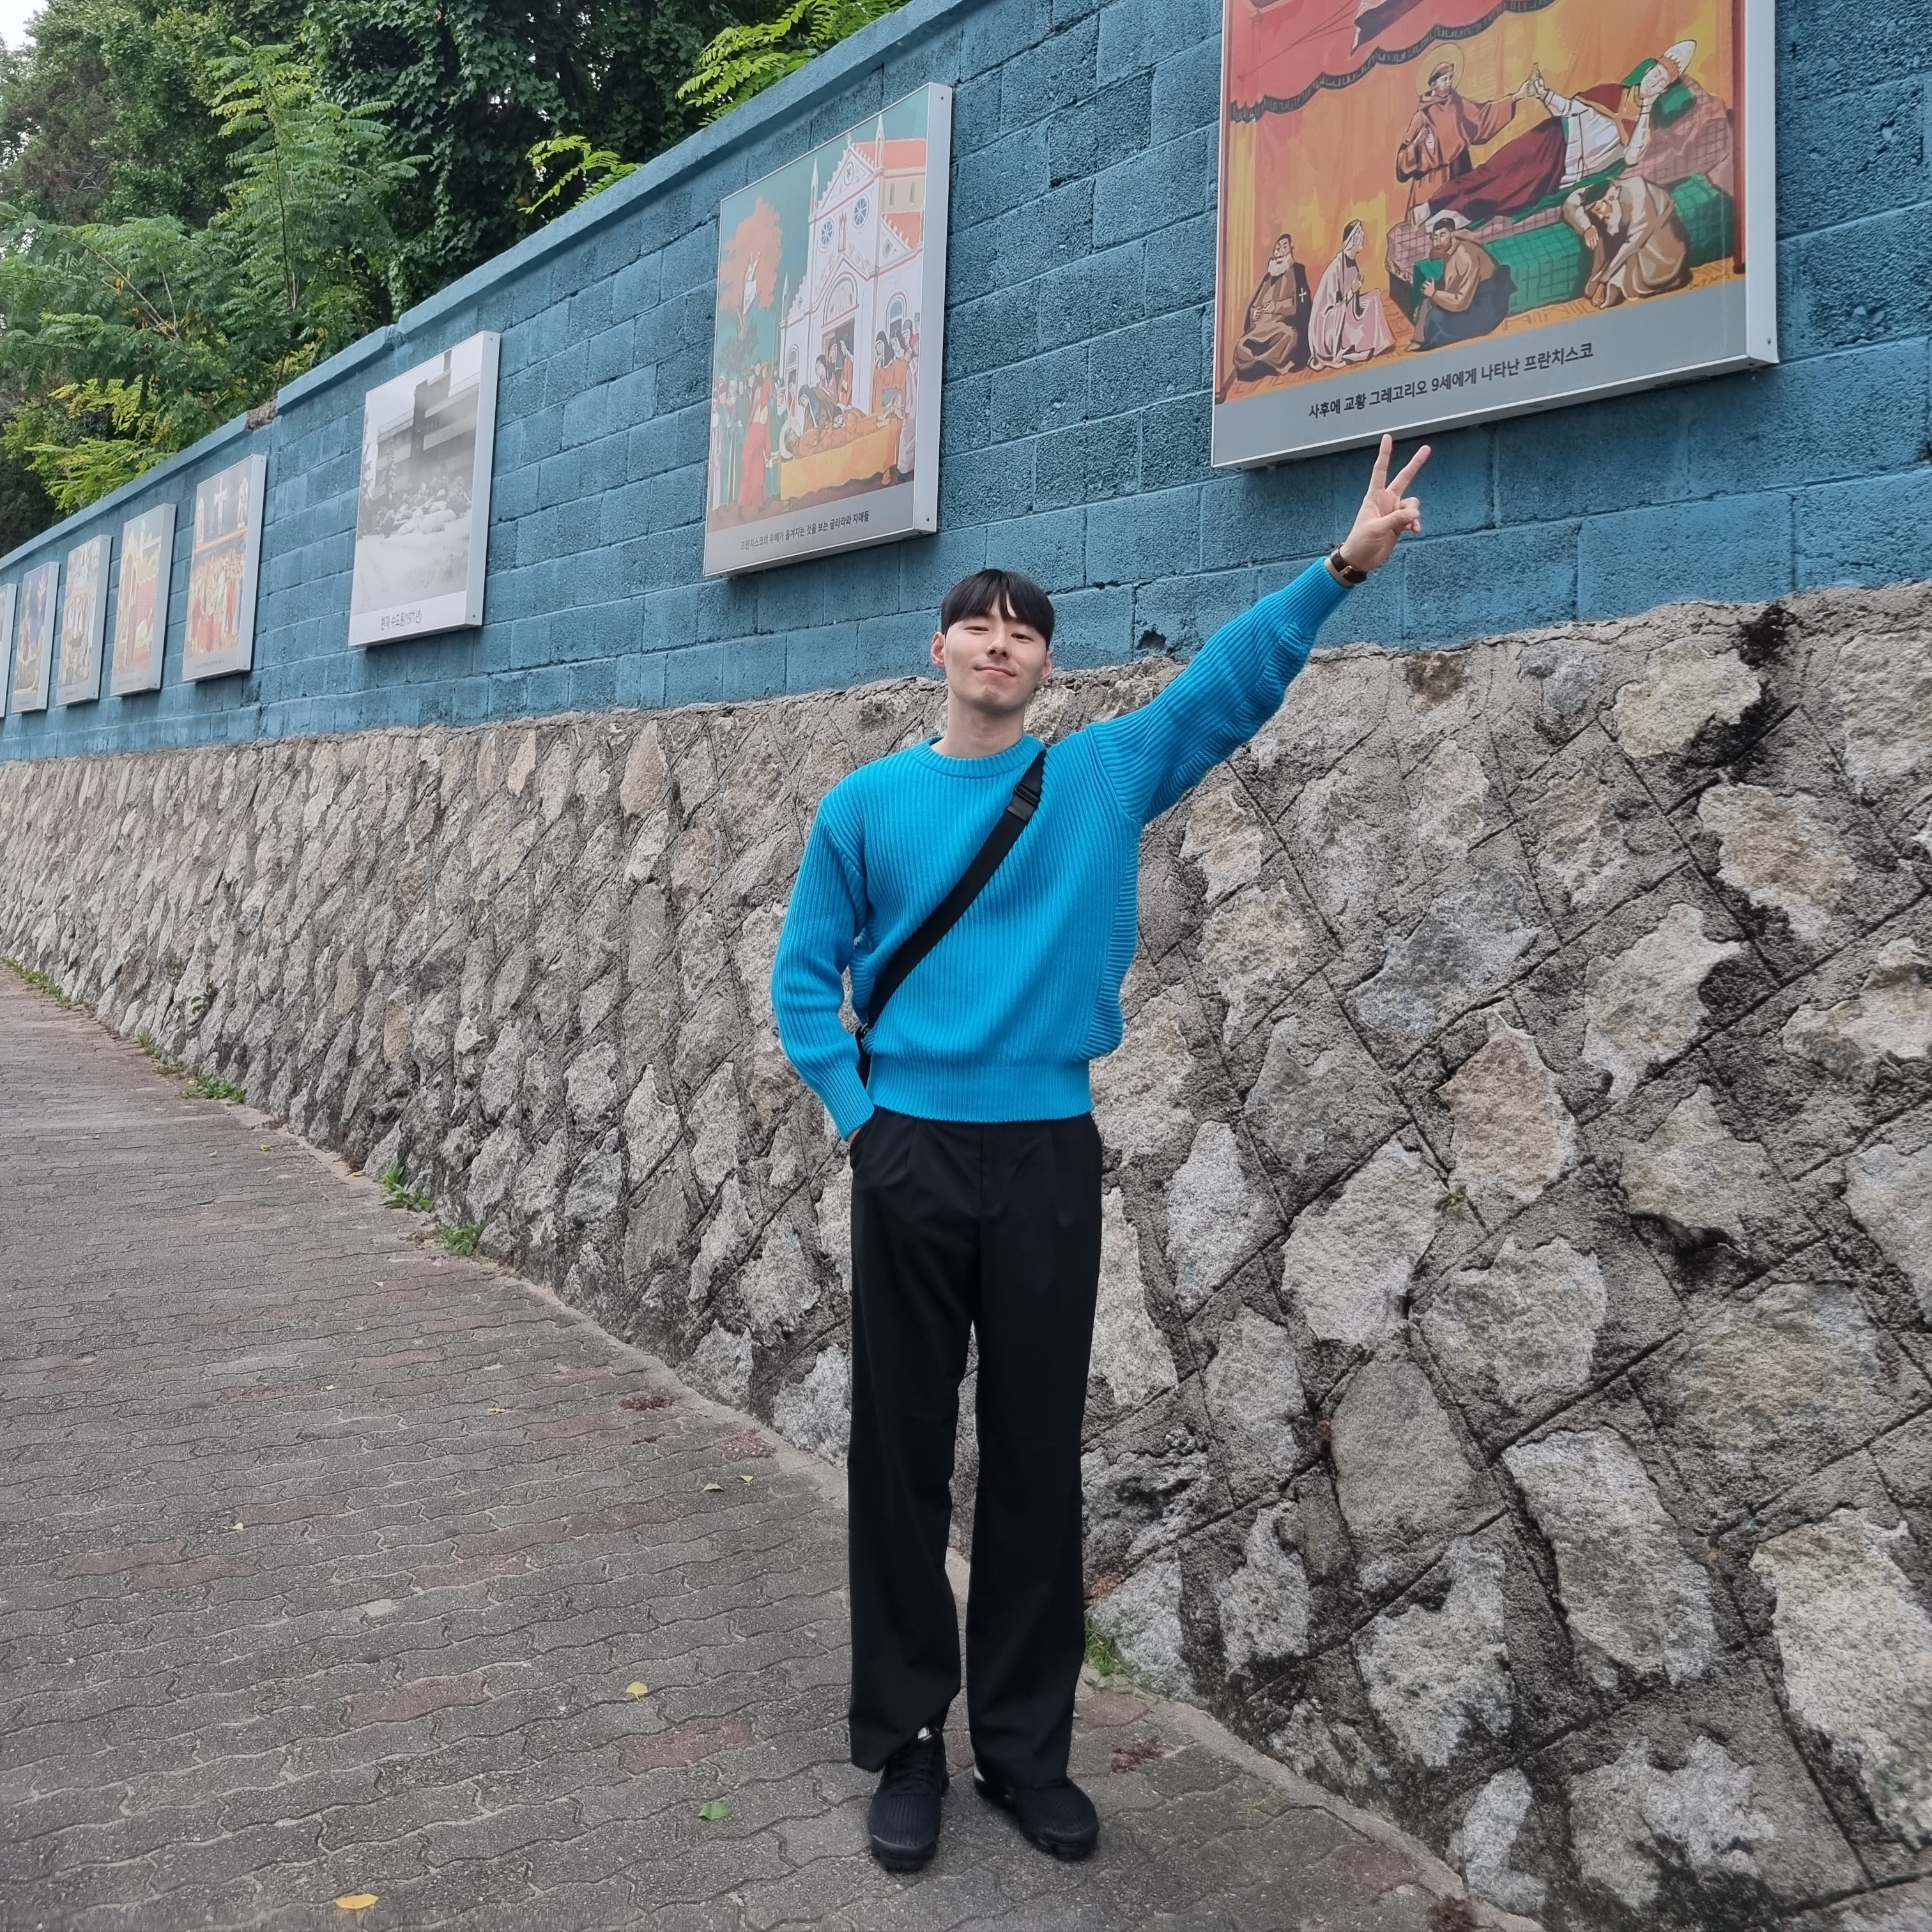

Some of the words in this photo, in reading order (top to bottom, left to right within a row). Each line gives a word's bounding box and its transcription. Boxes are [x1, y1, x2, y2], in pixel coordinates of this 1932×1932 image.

[1308, 399, 1341, 419] 사후에
[1344, 393, 1367, 410] 교황
[1369, 380, 1428, 406] 그레고리오
[1431, 367, 1477, 392] 9세에게
[1481, 358, 1520, 381] 나타난
[1523, 342, 1594, 372] 프란치스코
[740, 533, 769, 550] 프란치스코의
[769, 531, 785, 544] 유해가
[806, 523, 817, 535] 것을
[818, 521, 829, 532] 보는
[853, 510, 870, 525] 자매들
